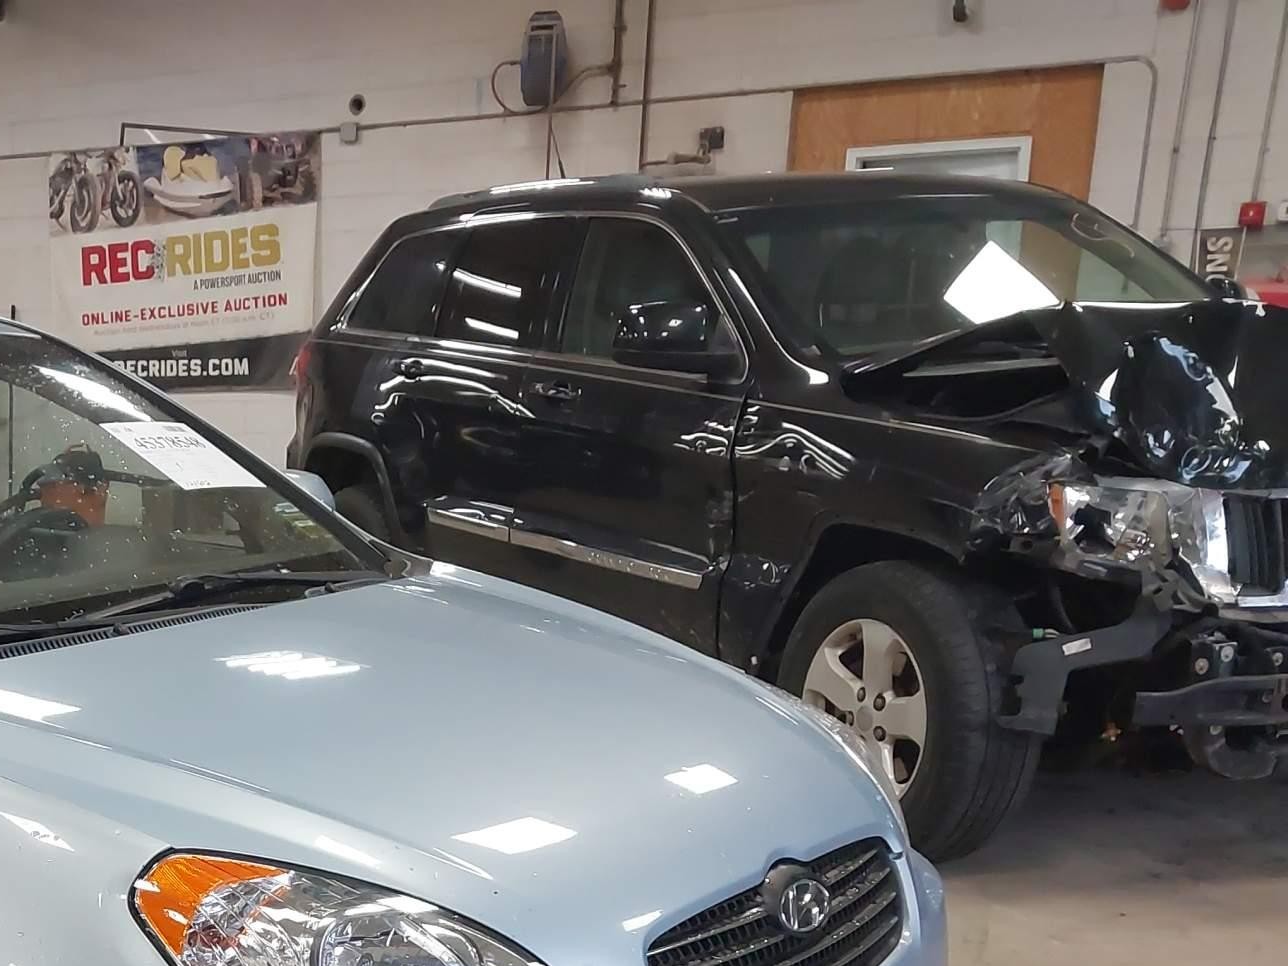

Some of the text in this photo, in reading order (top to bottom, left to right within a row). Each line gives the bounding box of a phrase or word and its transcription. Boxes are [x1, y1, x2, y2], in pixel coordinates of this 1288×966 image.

[81, 223, 281, 286] REC RIDES
[1205, 236, 1233, 282] NS
[193, 270, 282, 291] A POWERSPORT AUCTION
[81, 301, 218, 326] ONLINE-EXCLUSIVE
[224, 293, 288, 312] AUCTION
[134, 436, 207, 449] 45378548
